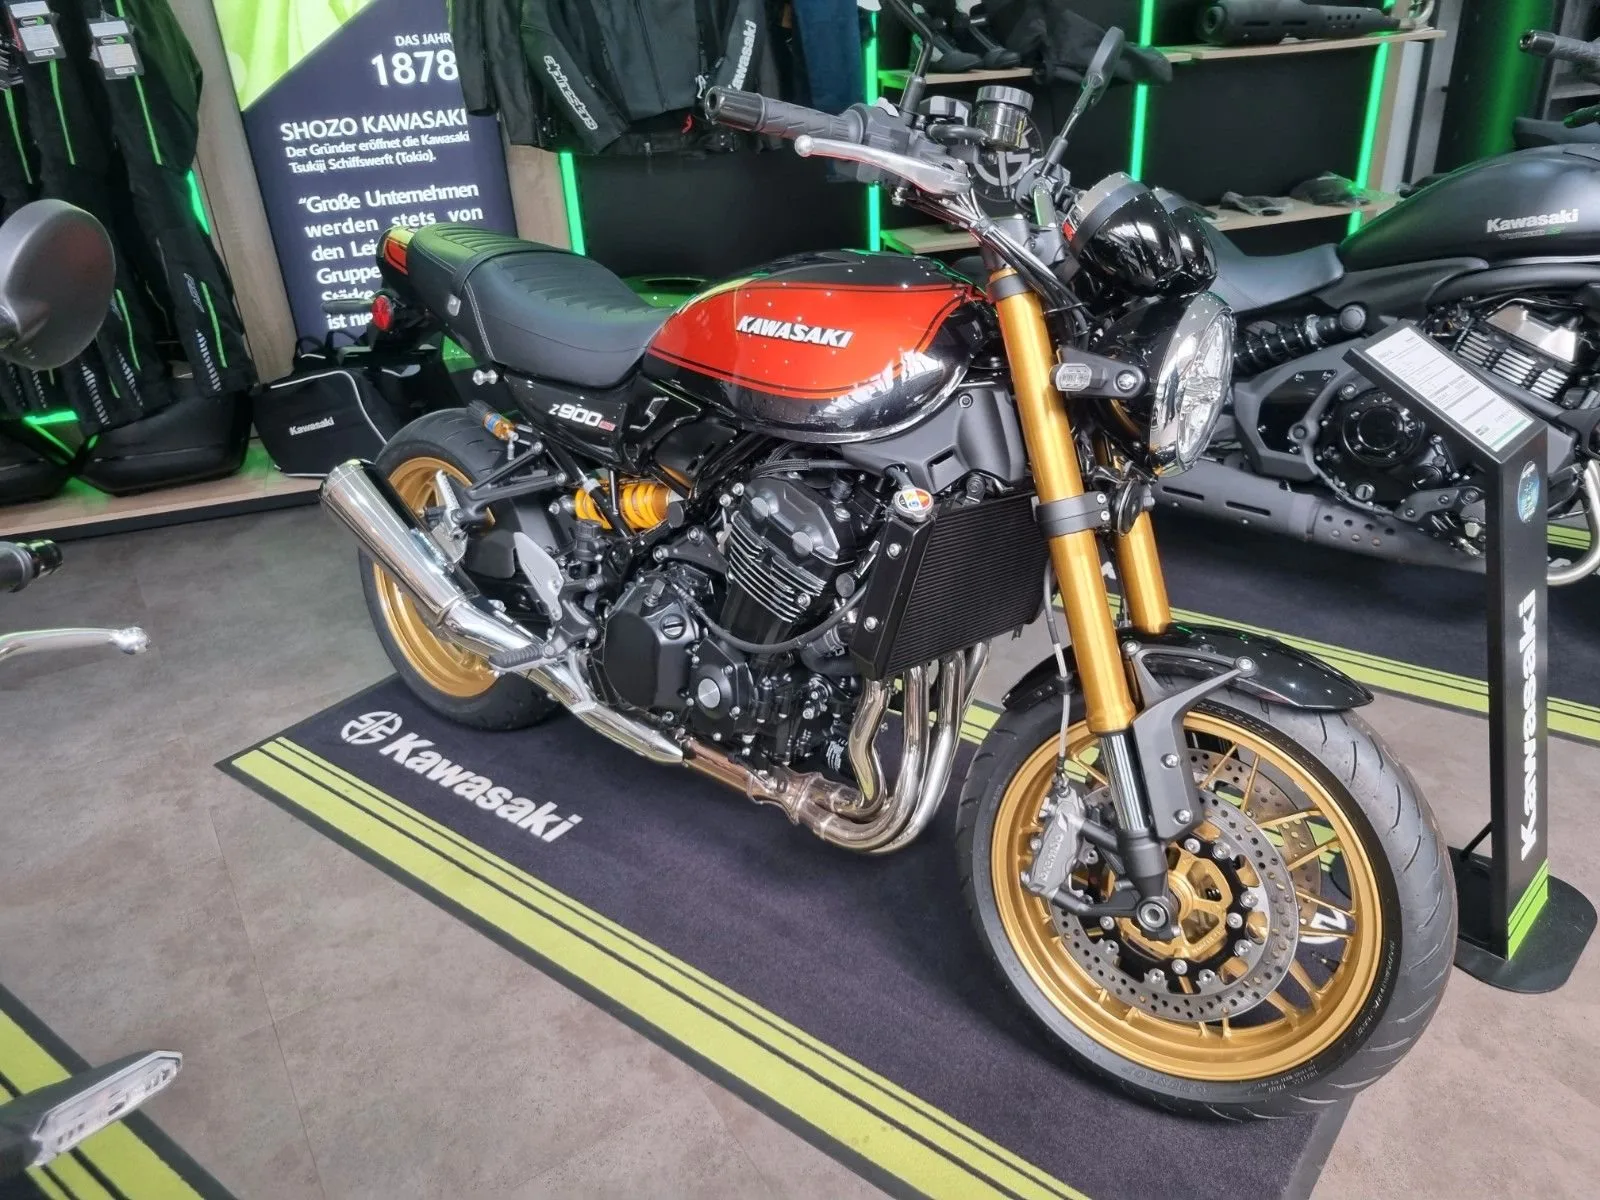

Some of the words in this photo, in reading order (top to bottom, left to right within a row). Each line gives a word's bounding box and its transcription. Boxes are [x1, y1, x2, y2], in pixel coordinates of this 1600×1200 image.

[395, 35, 419, 46] DAS
[422, 32, 452, 45] JAHR
[371, 49, 459, 86] 1878
[728, 19, 757, 91] awasaki
[280, 118, 357, 141] SHOZO
[362, 108, 468, 134] KAWASAKI
[285, 145, 307, 159] Der
[309, 139, 356, 156] Gründer
[358, 136, 400, 151] eröffnet
[402, 134, 419, 147] die
[421, 131, 470, 145] Kawasaki
[288, 160, 327, 174] Tsukiji
[329, 153, 394, 170] Schiffswerft
[396, 149, 437, 166] (Tokio).
[365, 184, 479, 207] Unternehmen
[305, 217, 378, 238] werden
[391, 211, 436, 228] stets
[447, 207, 483, 223] von
[1486, 209, 1579, 233] Kawasaki
[312, 244, 344, 262] den
[351, 239, 378, 258] Lei
[327, 314, 347, 330] ist
[735, 315, 854, 349] KAWASAKI
[289, 416, 335, 435] Kawasaki
[1518, 589, 1537, 861] Kawasaki
[378, 732, 583, 843] Kawasaki
